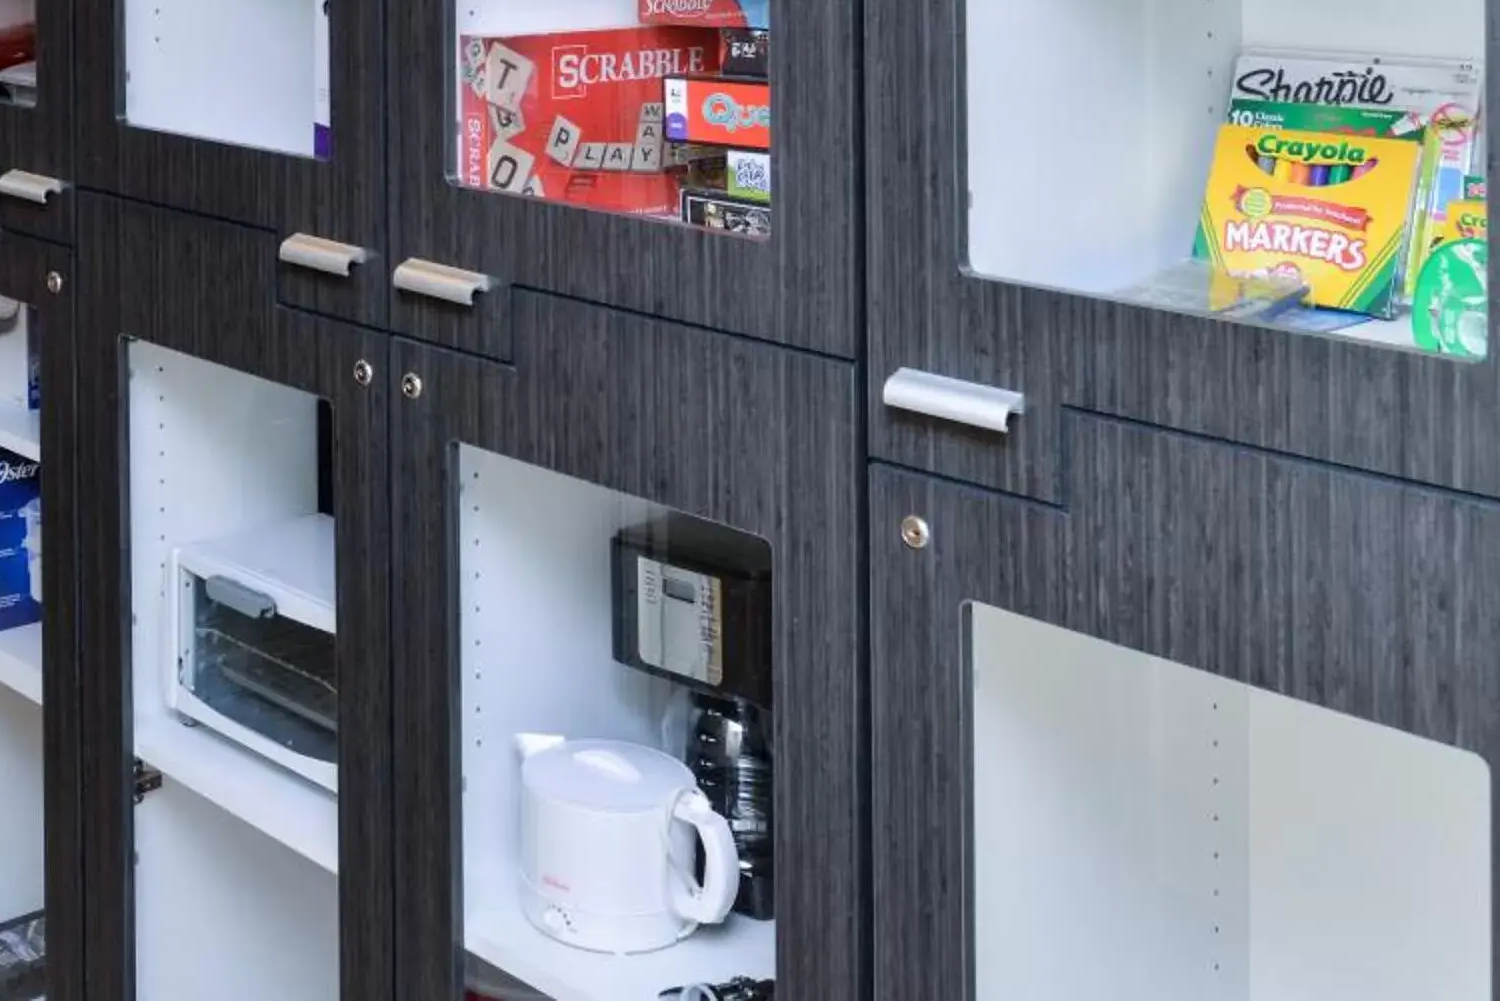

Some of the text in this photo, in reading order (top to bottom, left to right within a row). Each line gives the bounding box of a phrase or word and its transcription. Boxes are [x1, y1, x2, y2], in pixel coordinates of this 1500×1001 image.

[559, 46, 705, 89] SCRABBLE
[1236, 65, 1395, 105] Sharpie
[1257, 134, 1366, 162] Crayola
[1225, 220, 1366, 271] MARKERS
